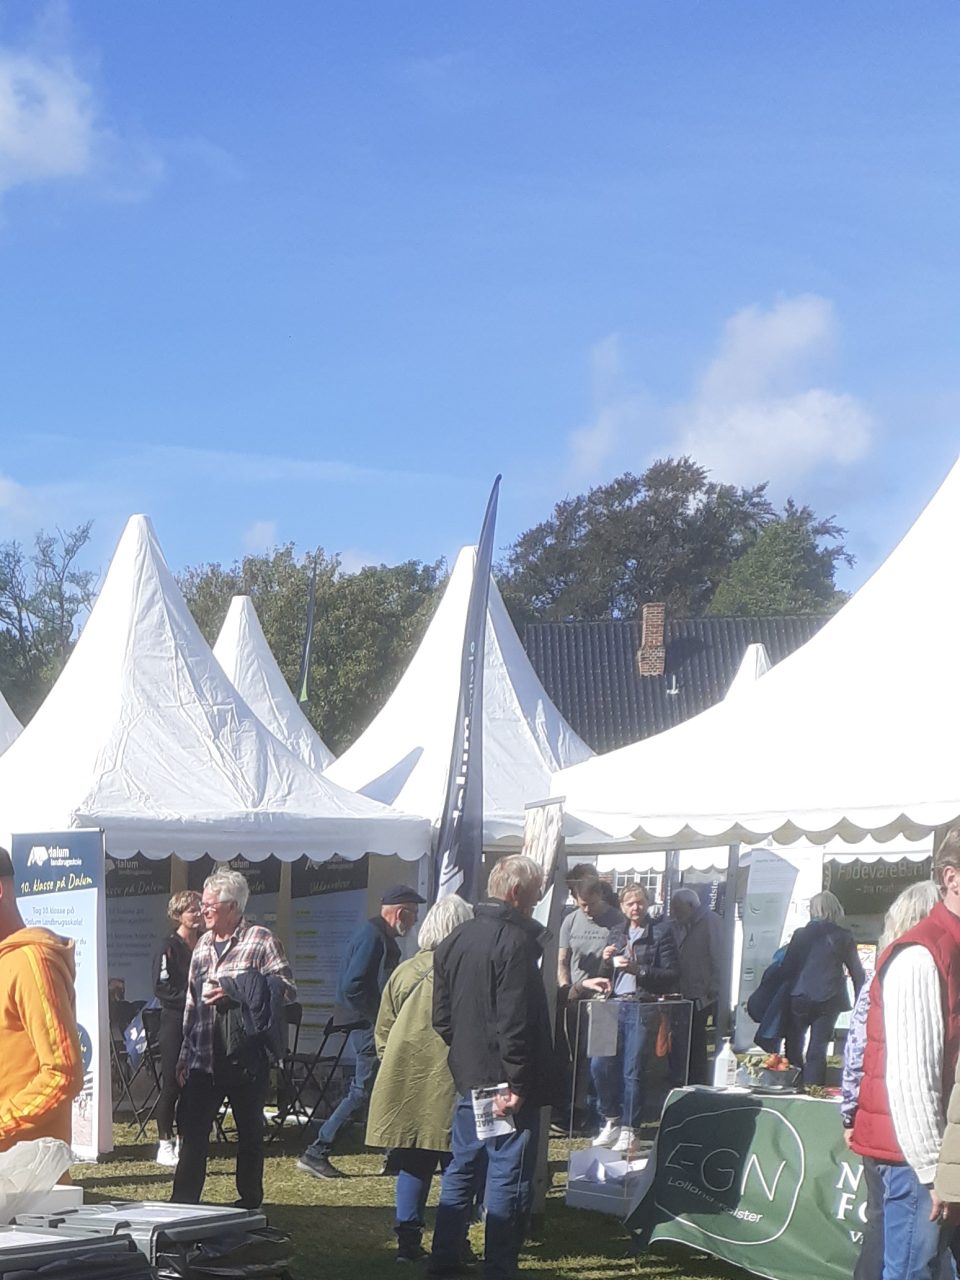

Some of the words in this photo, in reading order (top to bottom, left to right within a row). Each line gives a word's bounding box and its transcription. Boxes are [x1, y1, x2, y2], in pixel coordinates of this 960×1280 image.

[49, 846, 70, 857] dalum
[21, 881, 31, 893] 10.
[33, 878, 54, 891] klasse
[56, 876, 66, 891] på
[68, 873, 93, 889] Dalum
